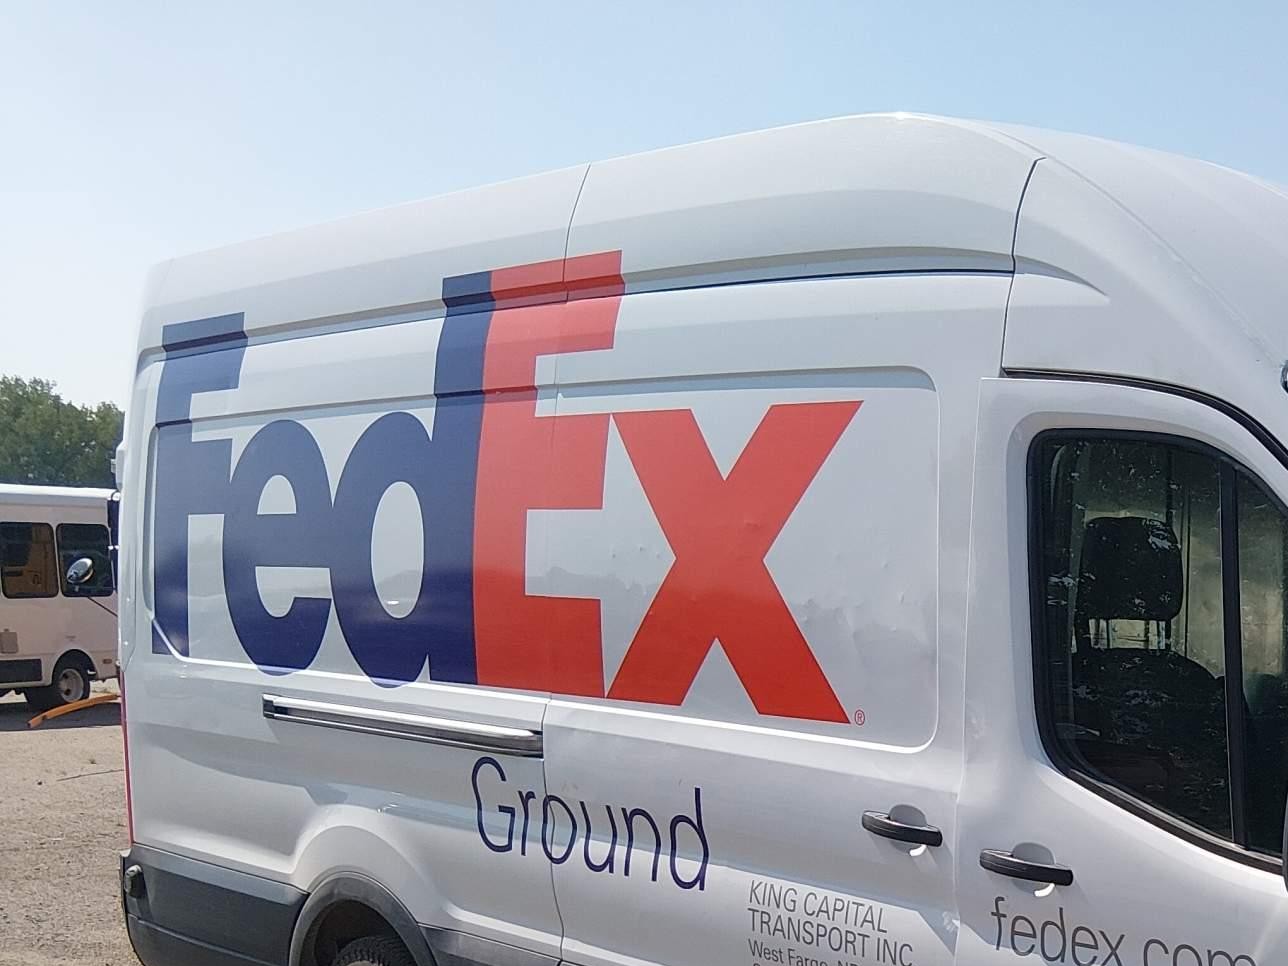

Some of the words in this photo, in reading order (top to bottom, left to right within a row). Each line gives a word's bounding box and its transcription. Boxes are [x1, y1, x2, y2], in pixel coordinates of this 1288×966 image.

[152, 250, 863, 724] FedEx
[471, 755, 710, 891] Ground
[747, 907, 871, 958] TRANSPORT
[749, 879, 798, 913] KING
[803, 891, 888, 934] CAPITAL
[747, 938, 785, 965] West
